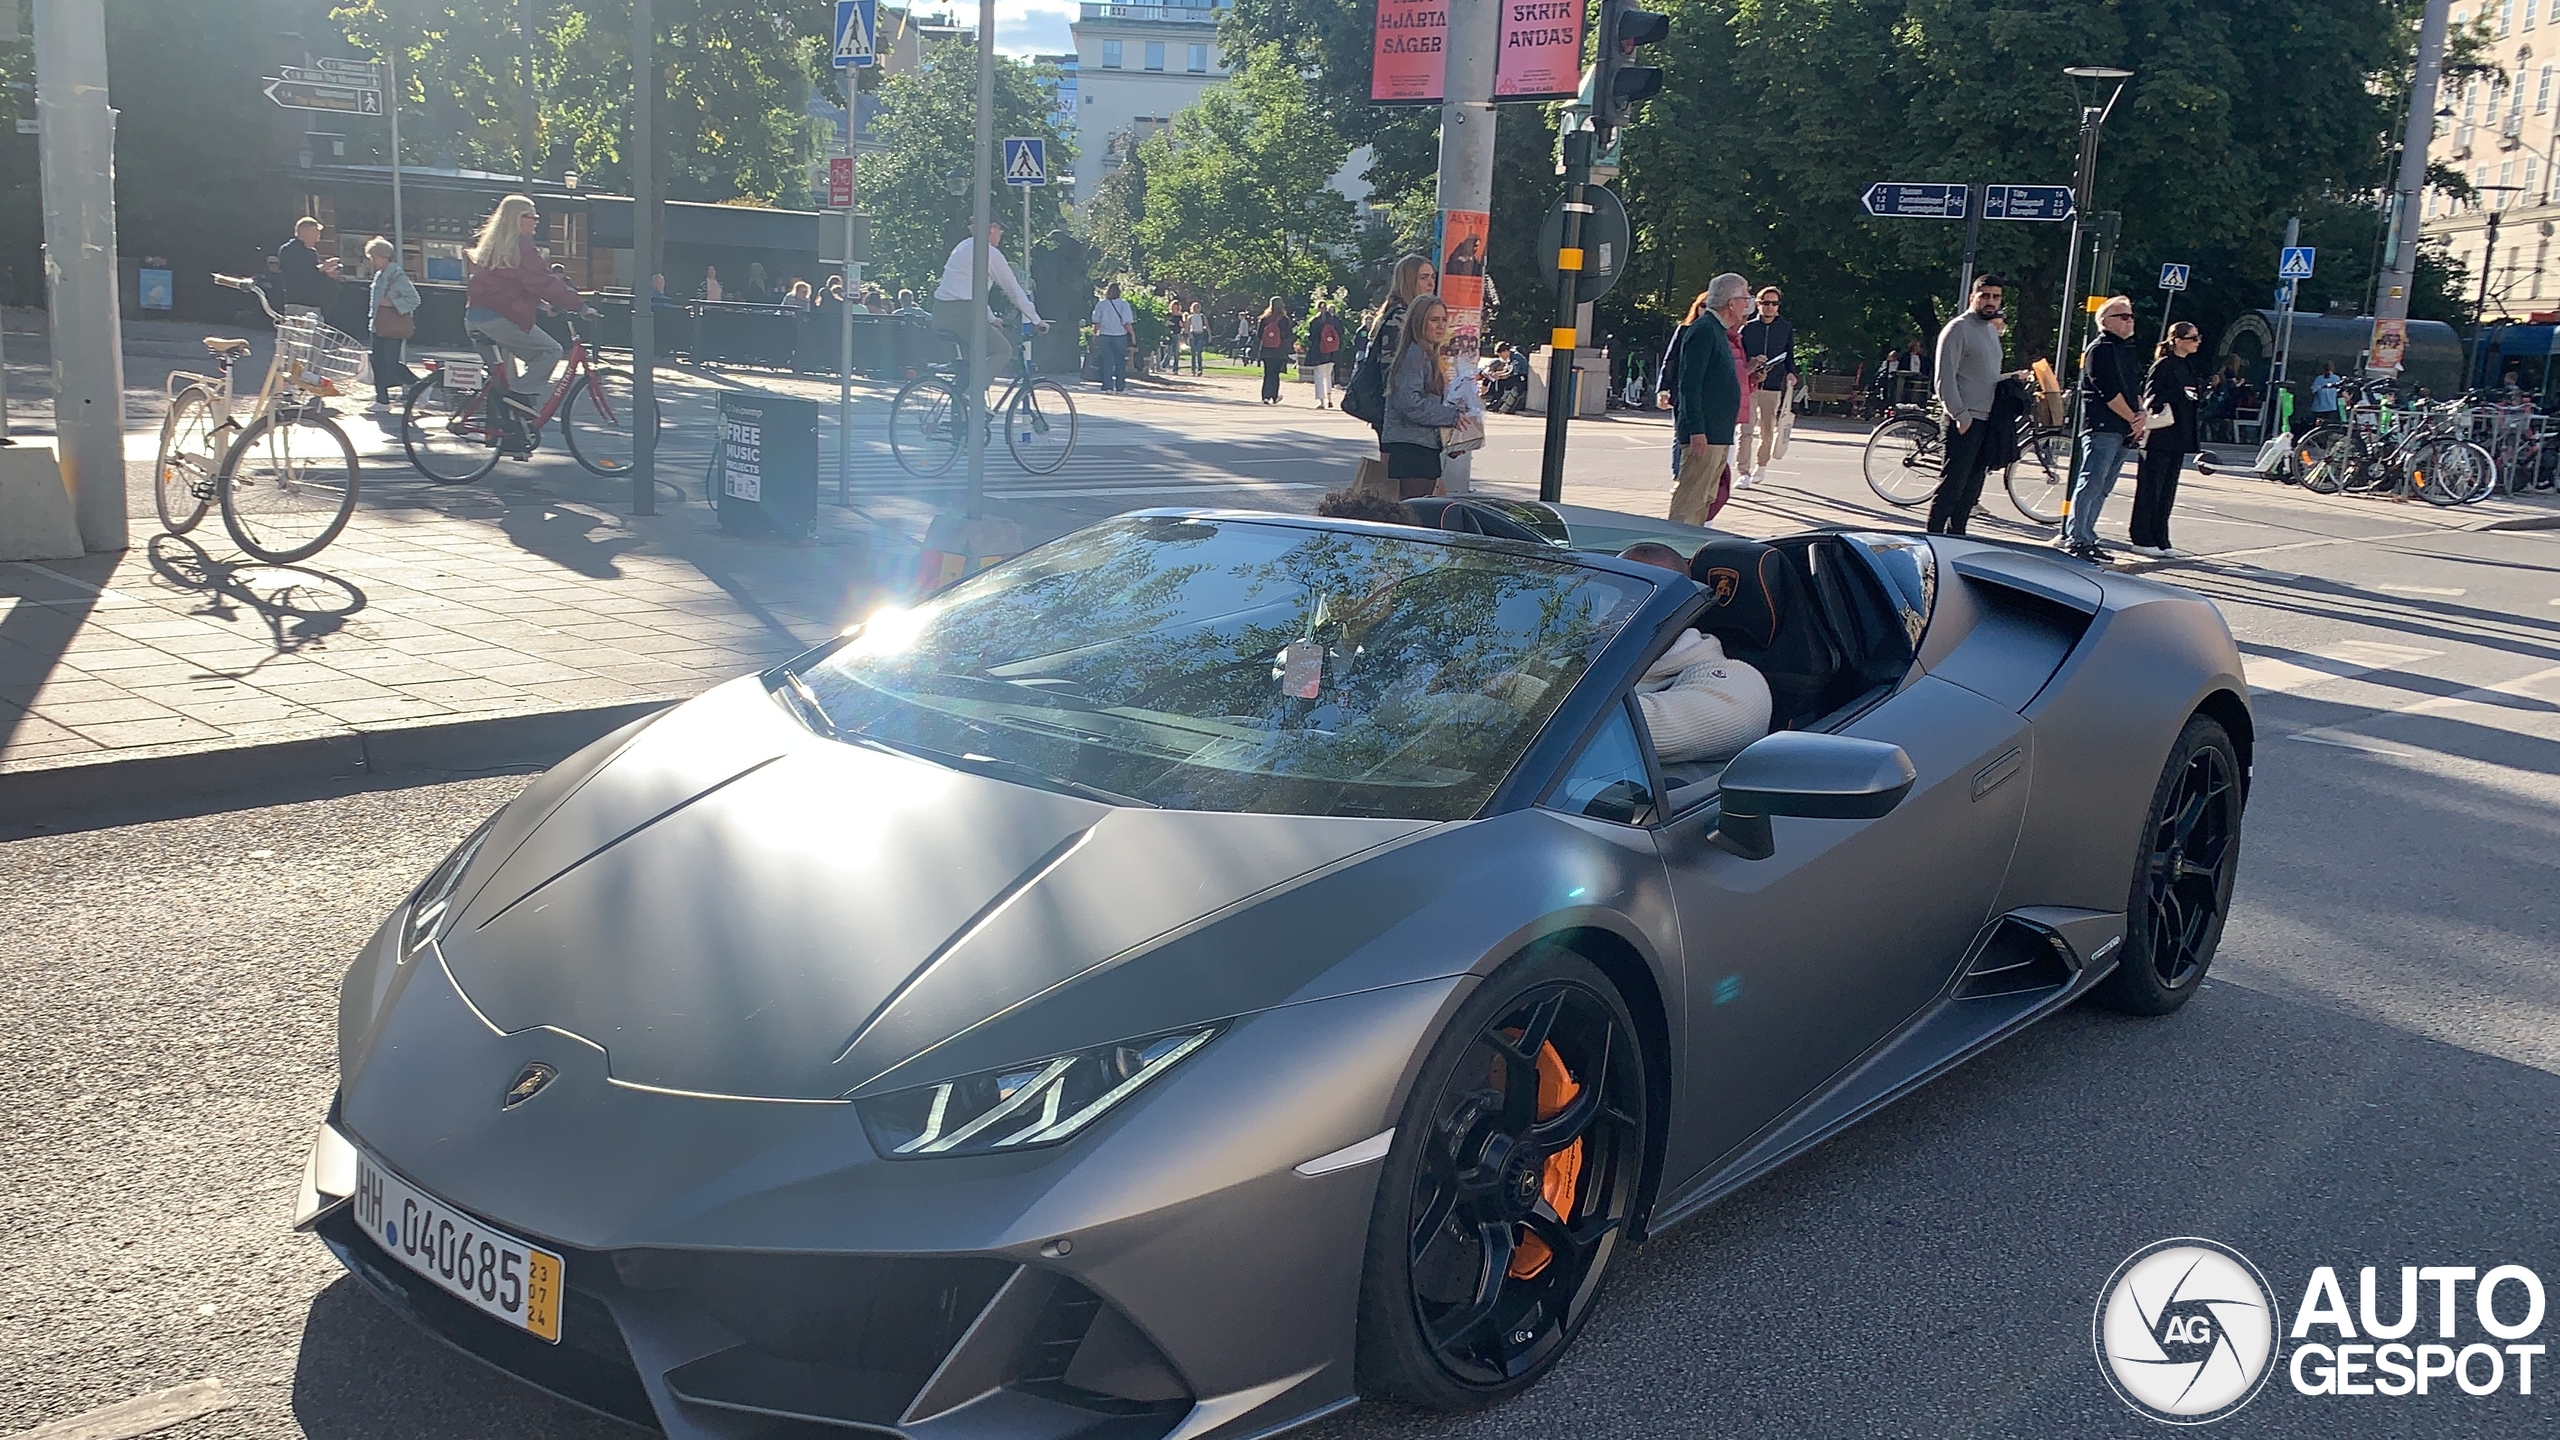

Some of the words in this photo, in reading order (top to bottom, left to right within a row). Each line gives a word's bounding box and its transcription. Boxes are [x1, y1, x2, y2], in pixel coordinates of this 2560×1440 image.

[1380, 9, 1447, 29] HJÄRTA
[1513, 1, 1572, 22] SKRIK
[1382, 34, 1442, 53] SÄGER
[1508, 27, 1574, 48] ANDAS
[554, 367, 575, 397] SPILTAN
[727, 422, 761, 446] FREE
[726, 443, 761, 463] MUSIC
[726, 459, 760, 474] PROJECTS
[359, 1161, 384, 1234] HH
[403, 1198, 522, 1313] 040685
[529, 1261, 547, 1283] 23
[528, 1284, 547, 1304] 07
[527, 1306, 546, 1326] 24
